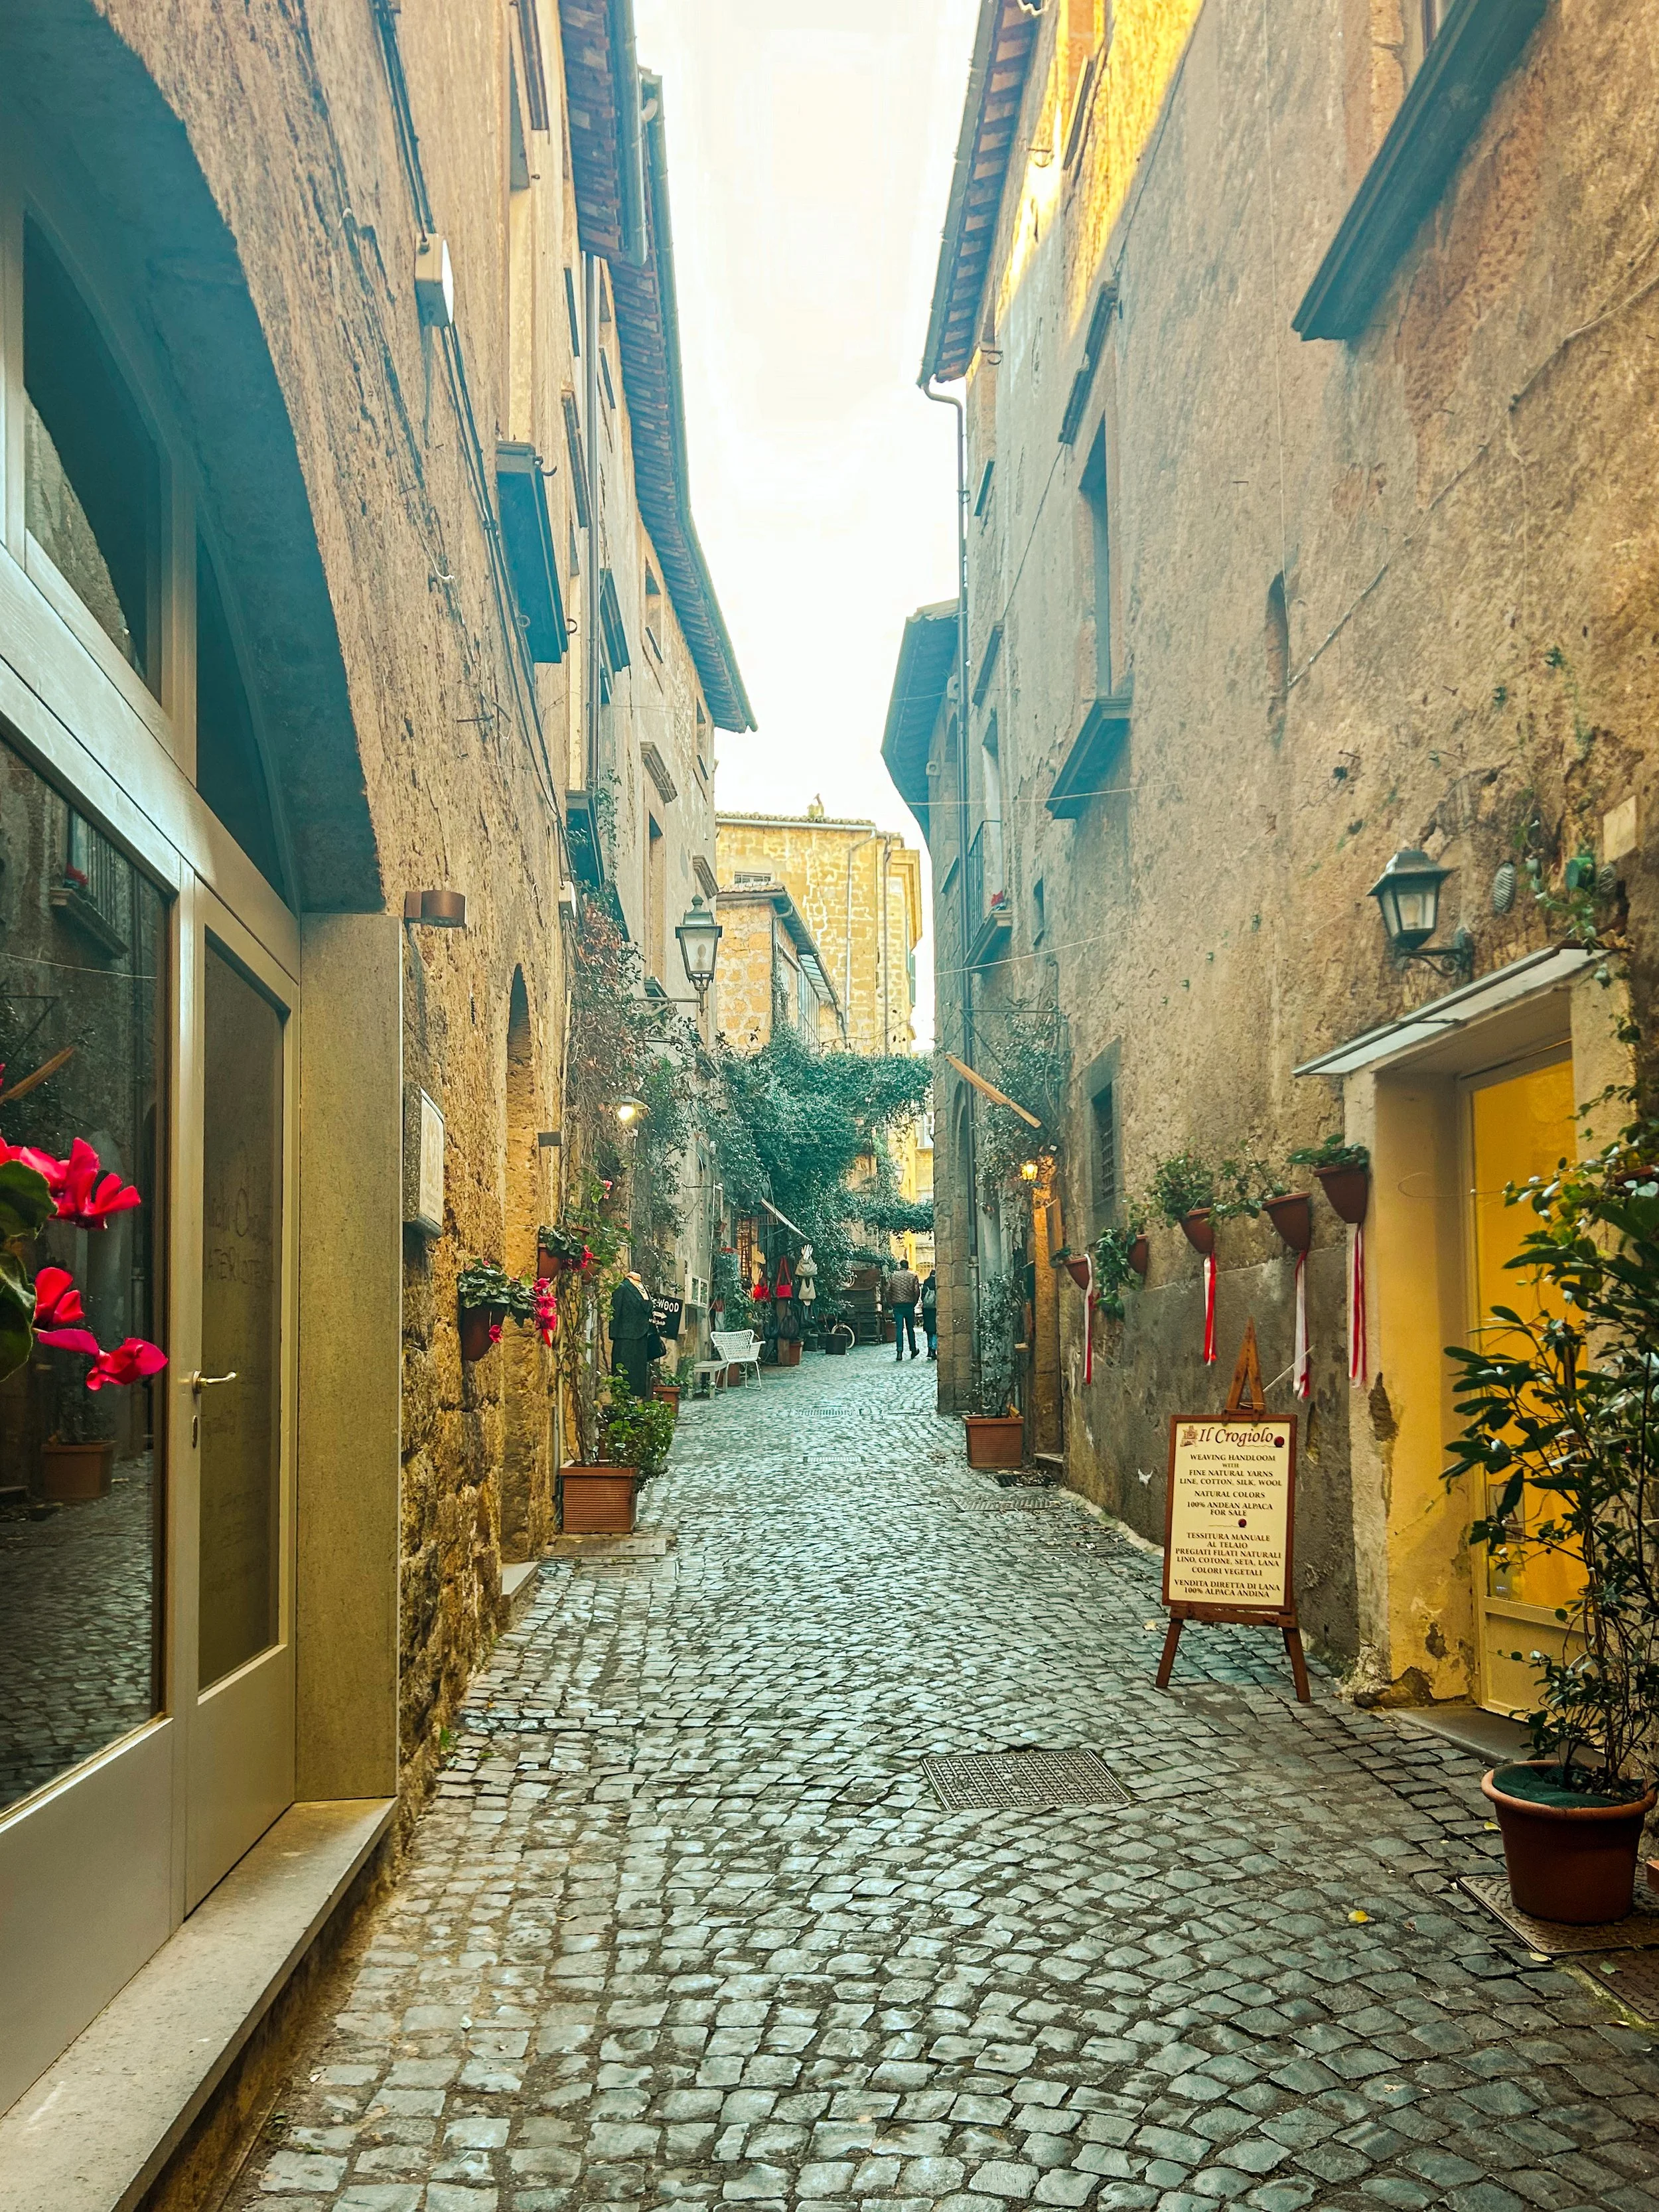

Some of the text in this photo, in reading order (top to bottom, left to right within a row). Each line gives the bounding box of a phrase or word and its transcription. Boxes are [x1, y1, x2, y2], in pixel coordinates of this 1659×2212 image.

[1198, 1427, 1273, 1447] Il Crogiolo
[1240, 1550, 1281, 1559] NATURALI
[1174, 1579, 1208, 1587] VENDITA
[1210, 1581, 1245, 1589] DIRETTA
[1237, 1589, 1269, 1598] ANDINA
